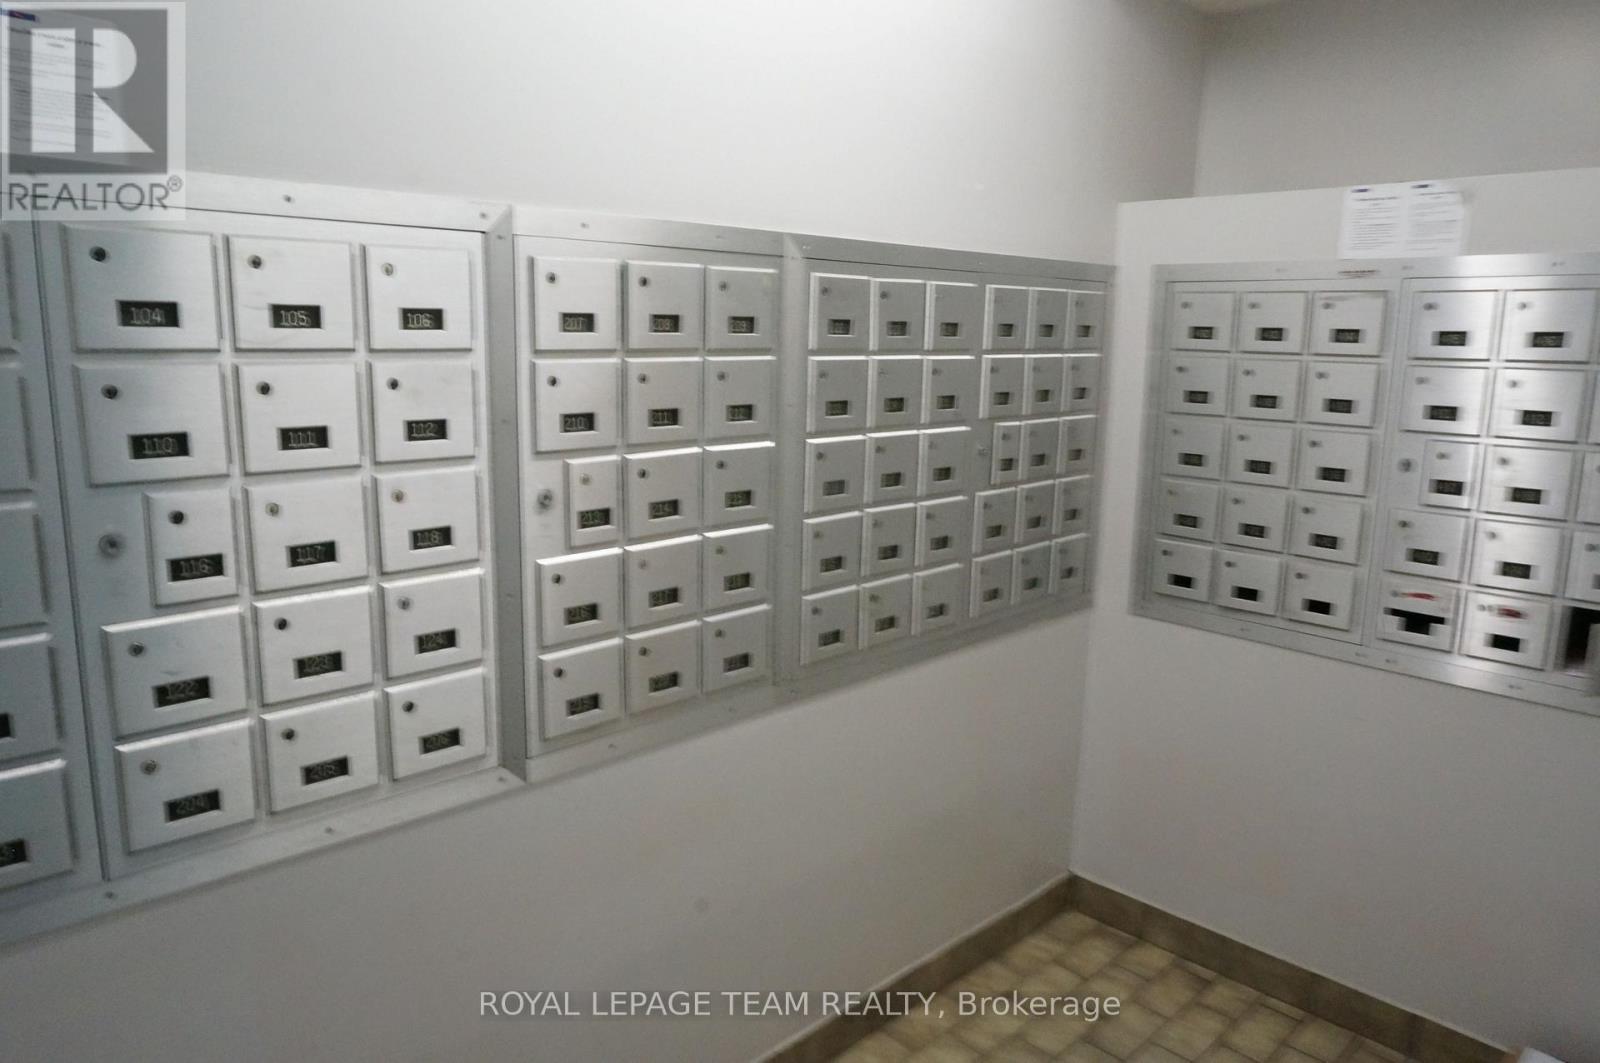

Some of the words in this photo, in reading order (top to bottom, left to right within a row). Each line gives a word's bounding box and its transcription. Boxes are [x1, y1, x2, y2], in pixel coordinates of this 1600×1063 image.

[129, 307, 166, 325] 104
[279, 310, 311, 328] 105
[405, 312, 435, 329] 106
[411, 422, 438, 439] 112
[142, 437, 177, 455] 110
[287, 431, 317, 448] 111
[415, 530, 442, 547] 118
[295, 545, 323, 564] 117
